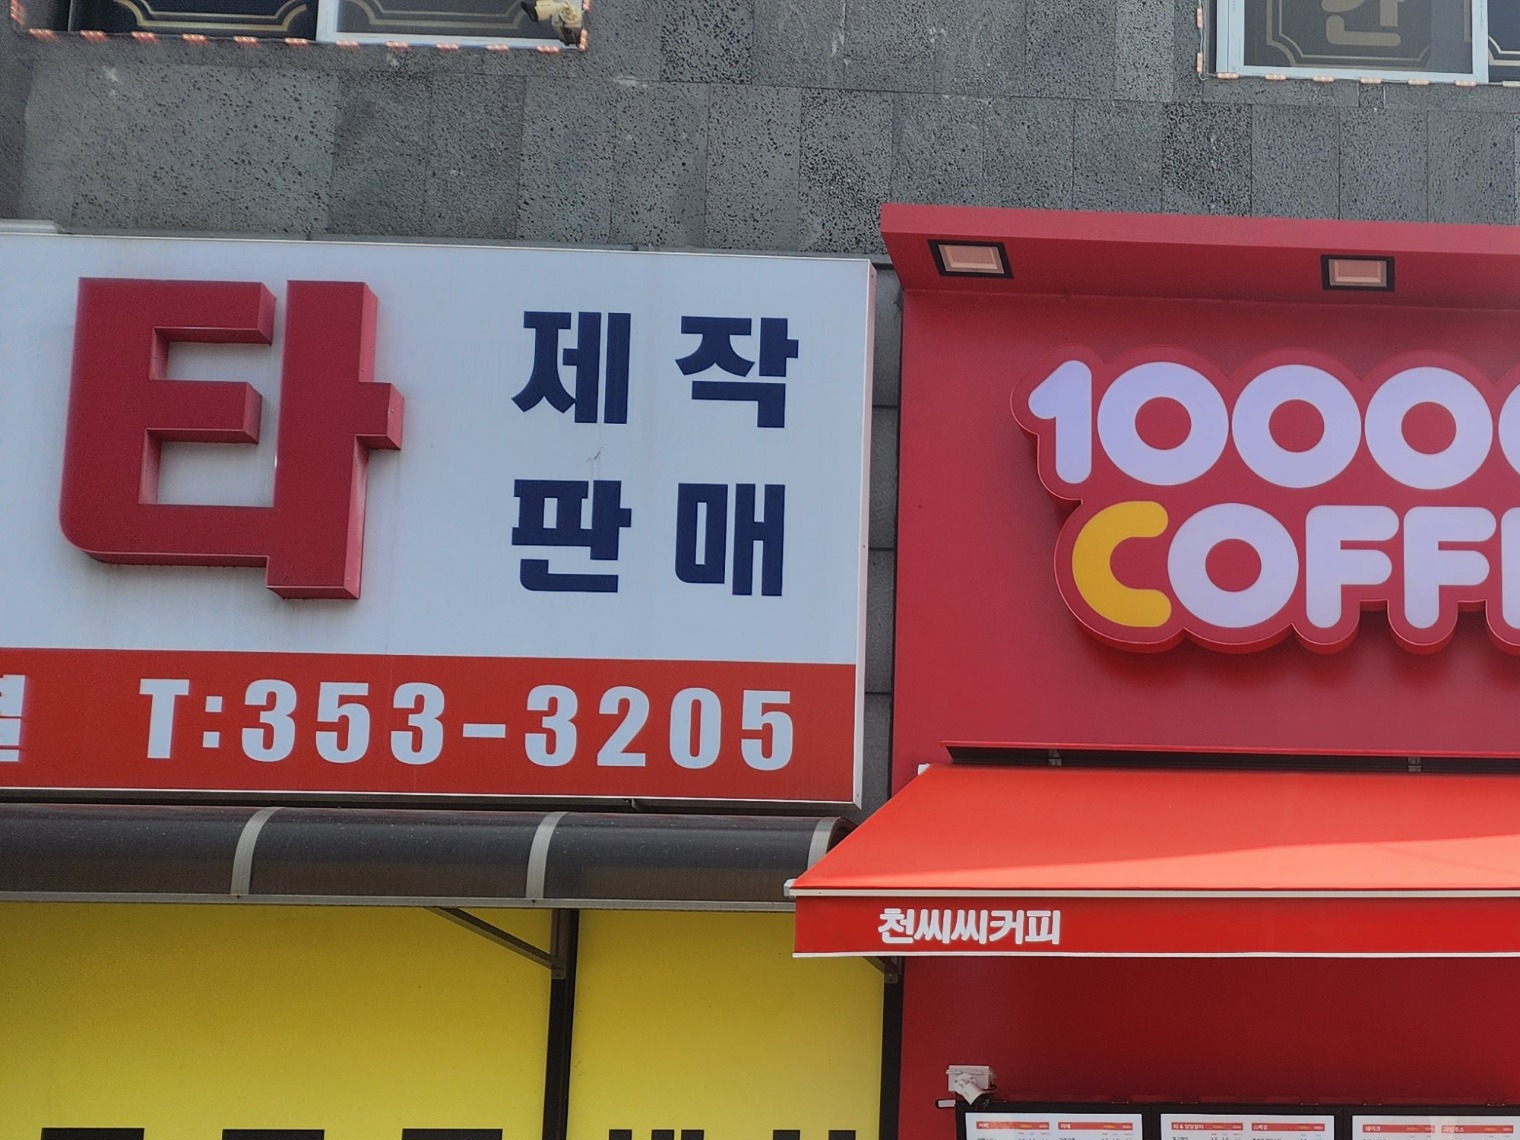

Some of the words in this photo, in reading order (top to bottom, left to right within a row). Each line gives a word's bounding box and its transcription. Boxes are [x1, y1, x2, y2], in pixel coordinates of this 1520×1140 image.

[512, 311, 798, 428] 제작
[60, 277, 404, 599] 타
[511, 480, 786, 596] 판매
[139, 678, 793, 770] T:353-3205
[878, 908, 1061, 945] 천씨씨커피
